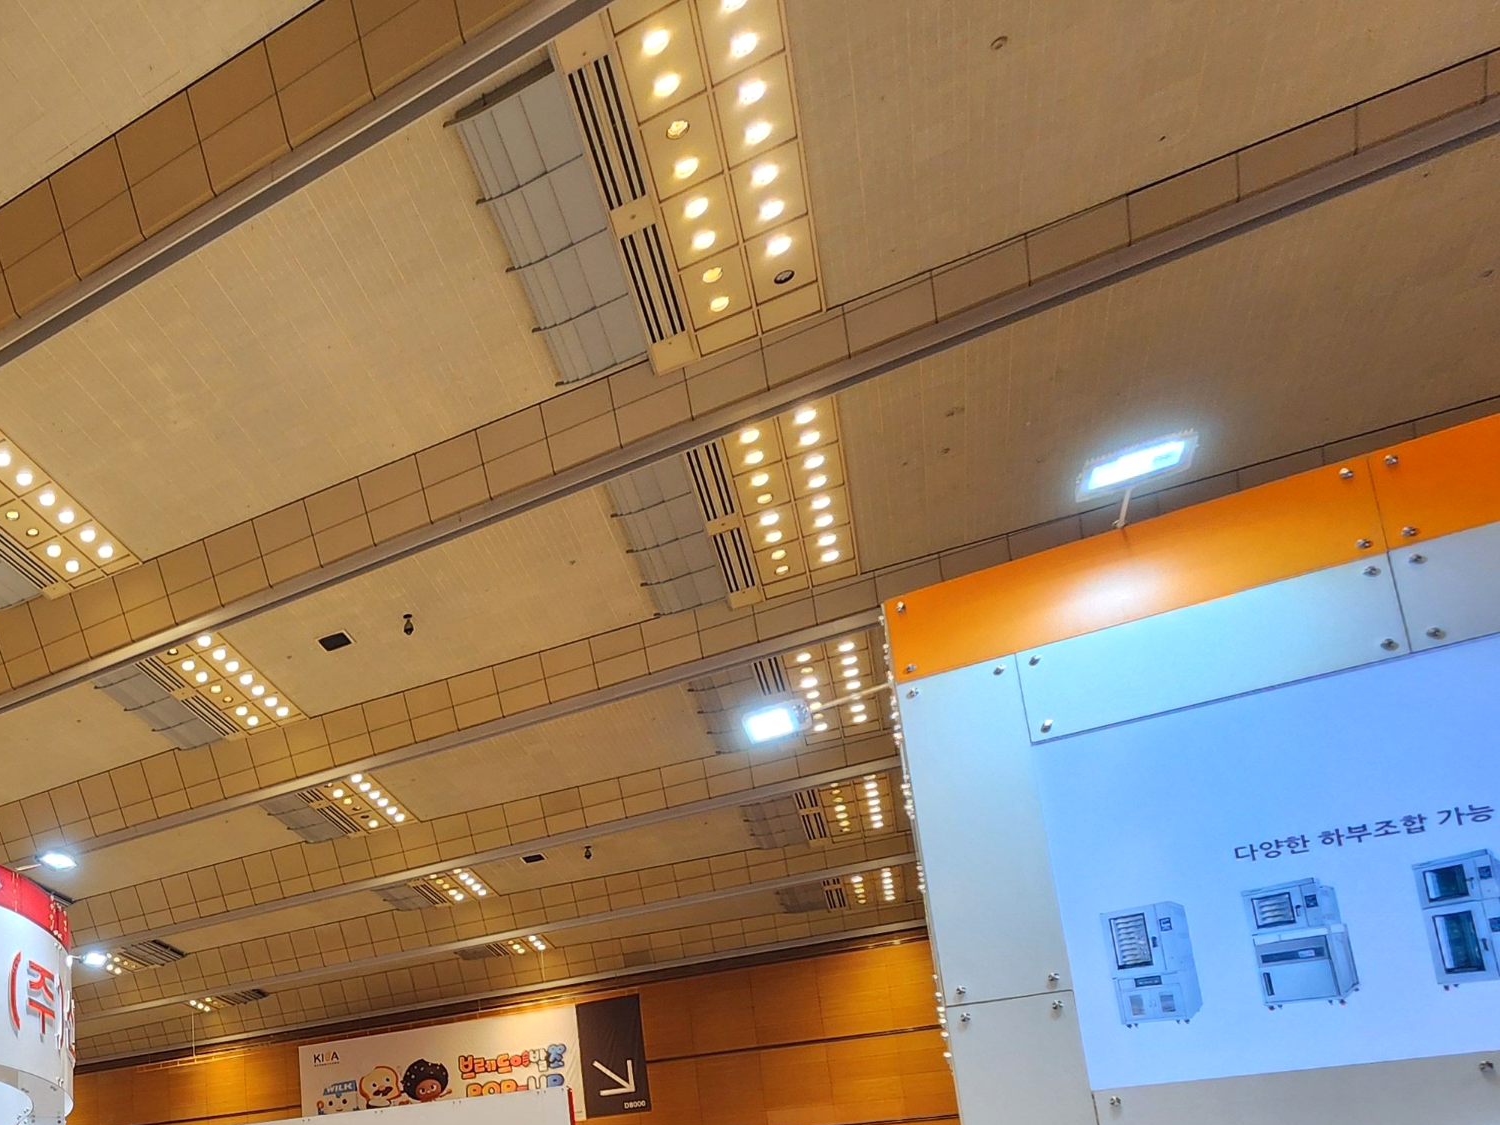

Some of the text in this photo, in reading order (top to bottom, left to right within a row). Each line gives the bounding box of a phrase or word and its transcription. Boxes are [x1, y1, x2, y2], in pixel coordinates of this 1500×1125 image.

[1234, 804, 1495, 862] 다양한 하부조합 가능
[623, 1100, 646, 1110] D8000
